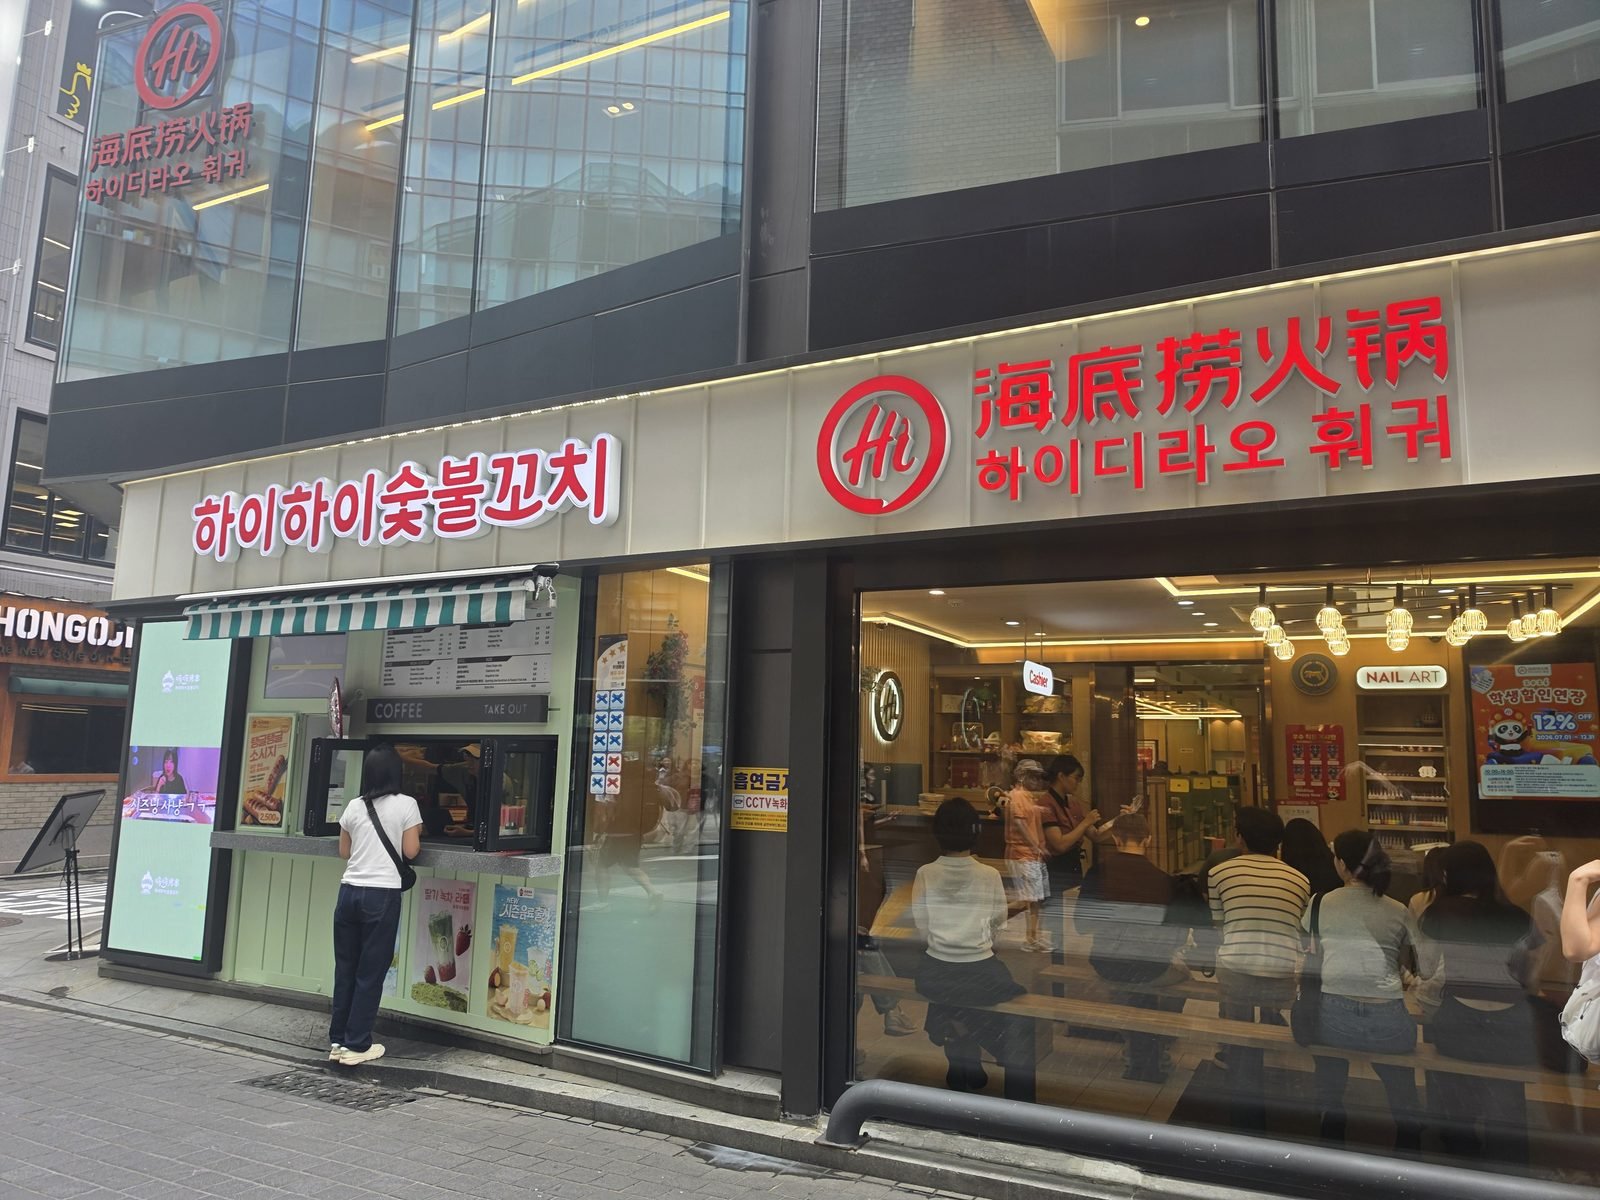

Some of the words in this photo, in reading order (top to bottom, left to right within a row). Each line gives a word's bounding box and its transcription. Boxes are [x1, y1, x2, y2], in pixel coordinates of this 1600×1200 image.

[89, 101, 253, 172] 海底捞火锅
[85, 163, 192, 204] 하이디라오
[200, 148, 246, 184] 훠궈
[973, 296, 1451, 440] 海底捞火锅
[975, 418, 1286, 502] 하이디라오
[1308, 394, 1453, 471] 훠궈
[192, 434, 615, 561] 하이하이숯불꼬치
[1029, 669, 1049, 688] Cashier
[1366, 671, 1404, 684] NAIL
[1408, 670, 1441, 683] ART
[375, 702, 424, 719] COFFEE
[484, 704, 505, 715] TAKE
[508, 703, 527, 715] OUT
[1533, 713, 1578, 732] 12%
[1577, 713, 1594, 721] OFF
[249, 744, 277, 762] 소시지
[130, 796, 160, 815] 시즈닝
[161, 798, 184, 816] 사냥
[506, 896, 520, 904] NEW
